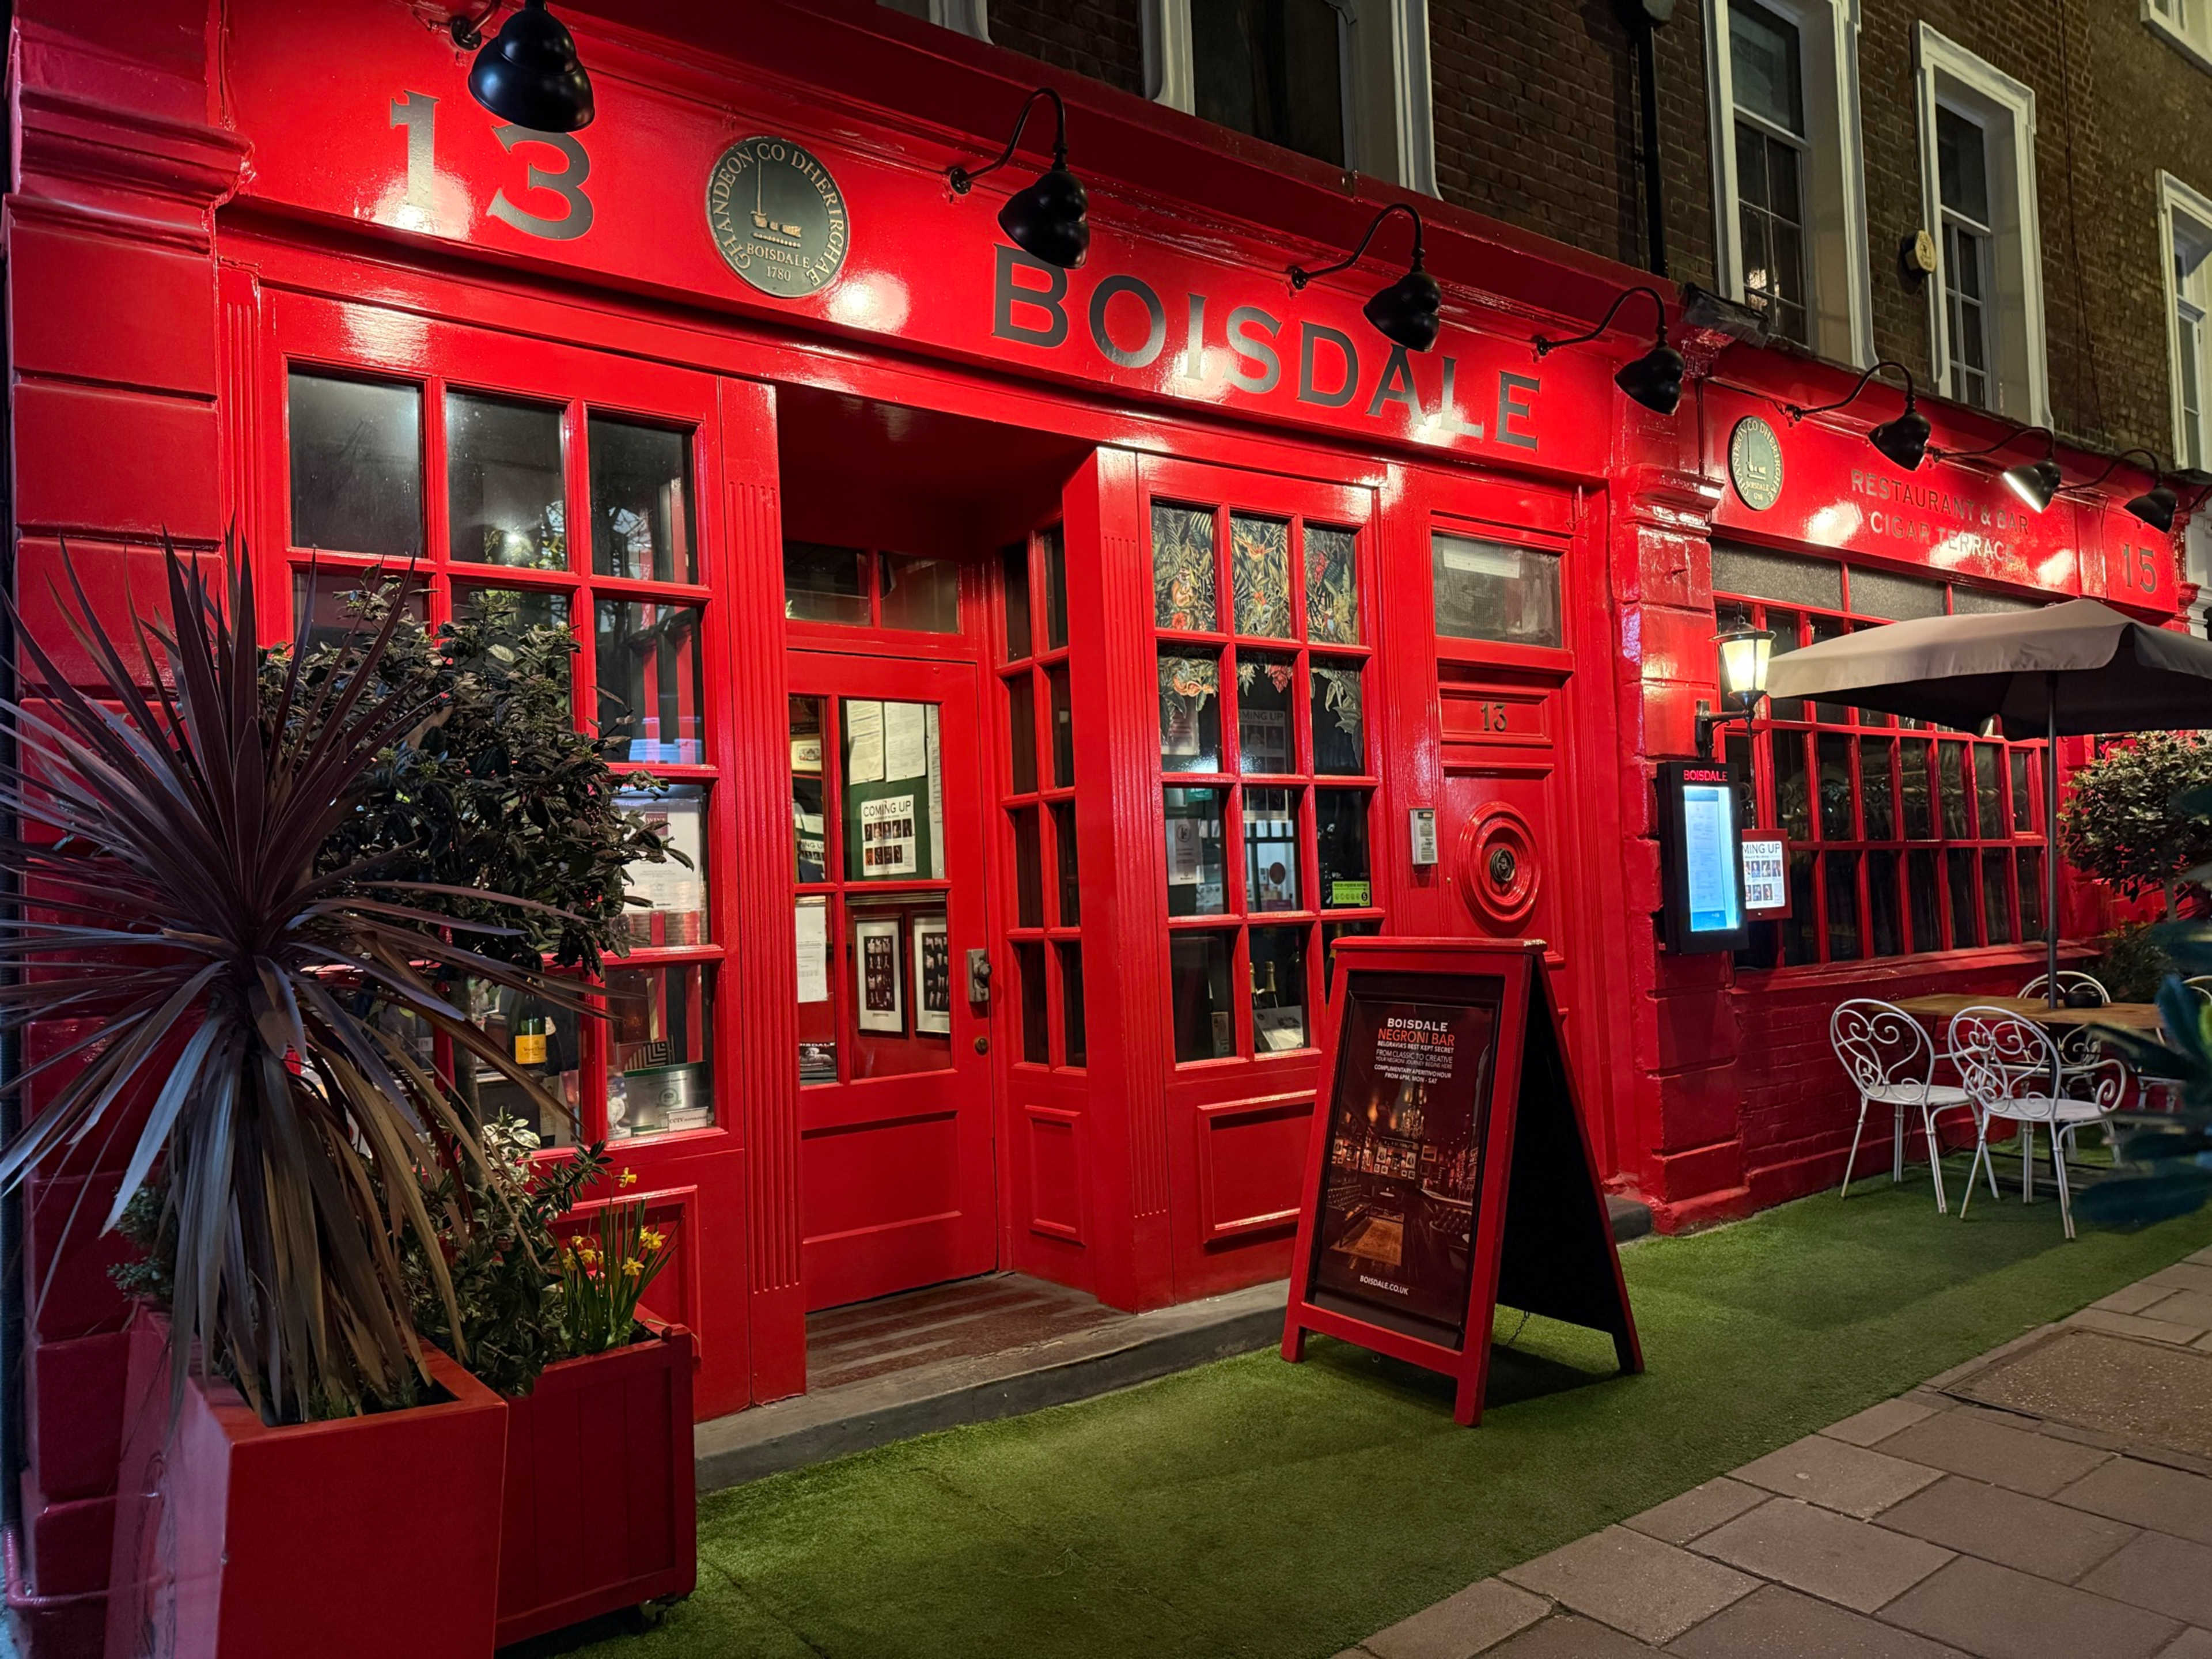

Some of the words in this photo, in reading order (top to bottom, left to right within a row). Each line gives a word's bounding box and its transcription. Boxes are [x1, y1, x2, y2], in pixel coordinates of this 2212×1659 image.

[390, 89, 594, 240] 13
[713, 146, 755, 270] GHANDEON
[756, 143, 785, 161] CO
[747, 243, 810, 268] BOISDALE
[766, 266, 791, 282] 1780
[991, 243, 1540, 452] BOISDALE
[1851, 469, 1975, 521] RESTAURANT
[1980, 509, 1991, 527] &
[1996, 509, 2029, 535] BAR
[1870, 511, 1930, 545] CIGAR
[1936, 527, 2017, 563] TERRACE
[2123, 543, 2156, 593] 15
[1480, 702, 1508, 732] 13
[1683, 770, 1728, 781] BOISDALE
[863, 802, 896, 817] COMING
[899, 800, 911, 812] UP
[1767, 843, 1781, 854] UP
[1387, 1017, 1449, 1032] BOISDALE
[1377, 1028, 1429, 1044] NEGRONI
[1431, 1032, 1456, 1047] BAR
[1392, 1050, 1415, 1059] CLASSIC
[1425, 1054, 1453, 1063] CREATIVE
[1434, 1046, 1455, 1054] SECRET
[1374, 1064, 1412, 1073] COMPLIMENTARY
[1359, 1275, 1409, 1296] BOISDALE.CO.UK
